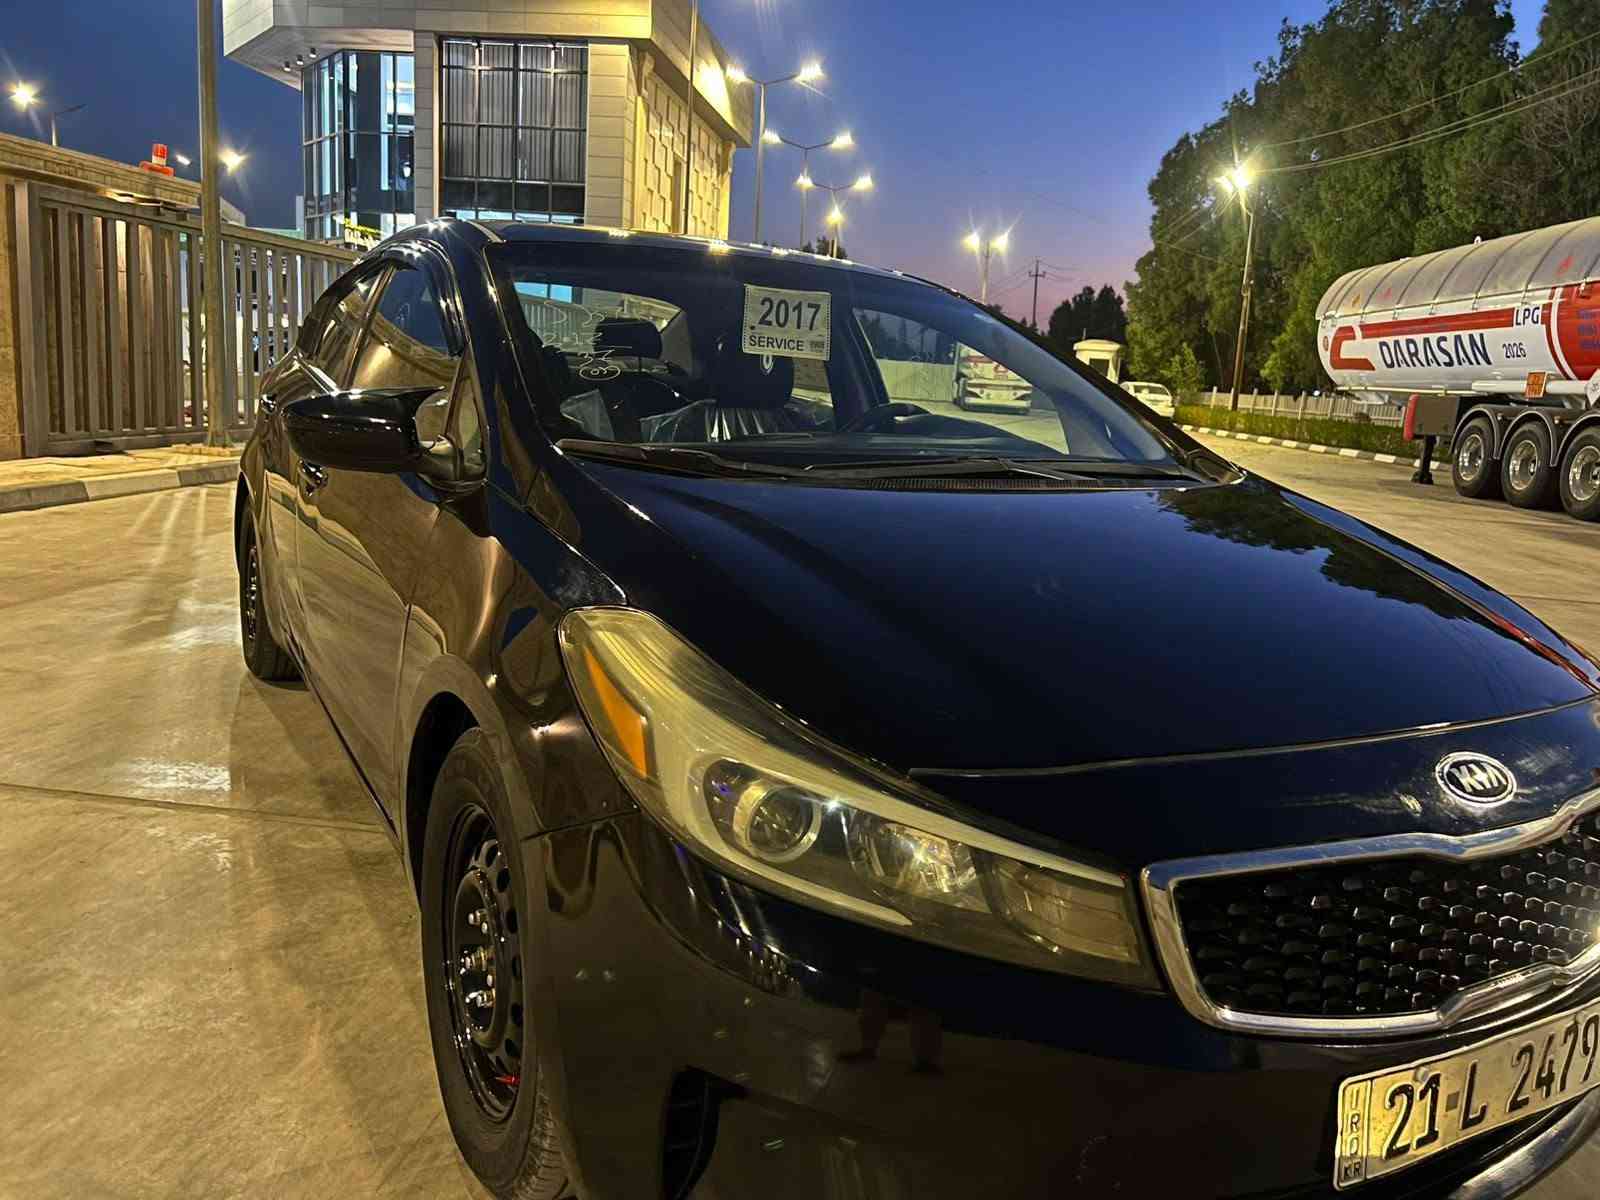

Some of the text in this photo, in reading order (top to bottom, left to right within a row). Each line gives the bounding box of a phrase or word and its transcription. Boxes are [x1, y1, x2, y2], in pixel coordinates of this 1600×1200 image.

[757, 296, 822, 332] 2017
[1515, 306, 1540, 326] LPG
[748, 334, 805, 352] SERVICE
[1379, 333, 1492, 368] DARASAN
[1502, 342, 1527, 359] 2026
[1382, 1014, 1600, 1161] 21 L 2479
